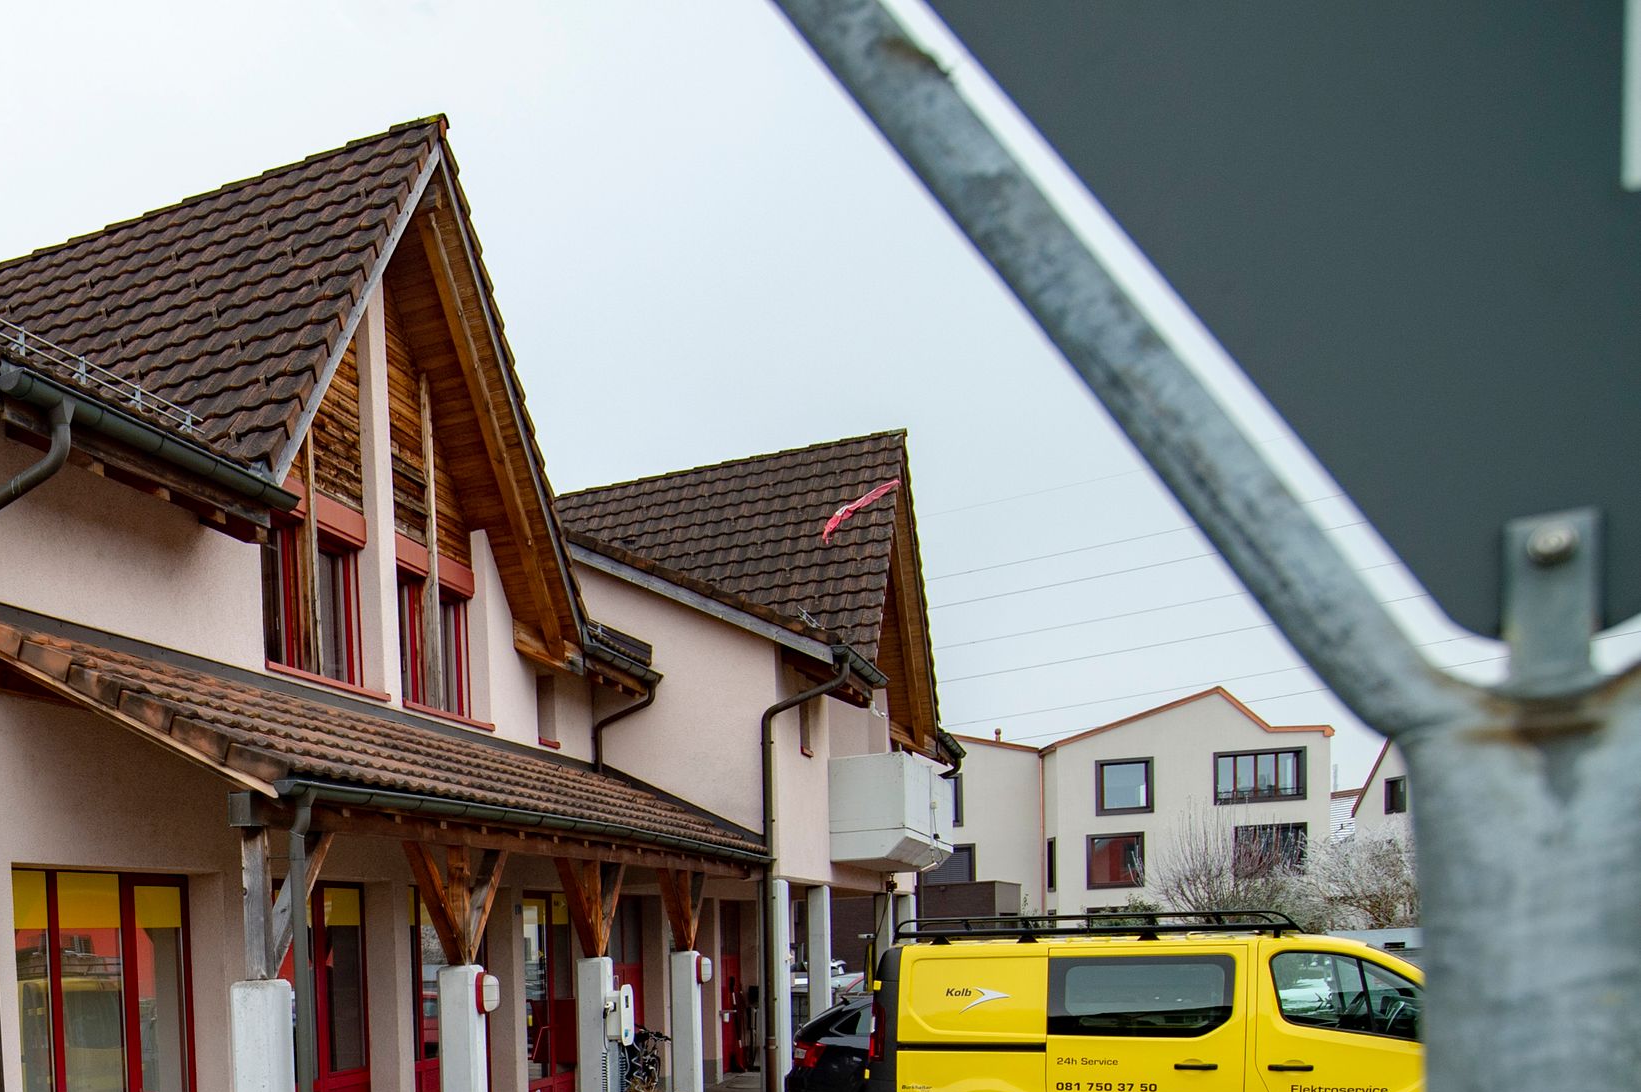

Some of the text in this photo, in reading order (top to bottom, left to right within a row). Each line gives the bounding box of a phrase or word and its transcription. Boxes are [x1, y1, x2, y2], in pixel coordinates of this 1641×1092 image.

[945, 987, 972, 997] Kolb
[1056, 1057, 1119, 1066] 24h Service
[1056, 1082, 1158, 1092] 081 750 37 50
